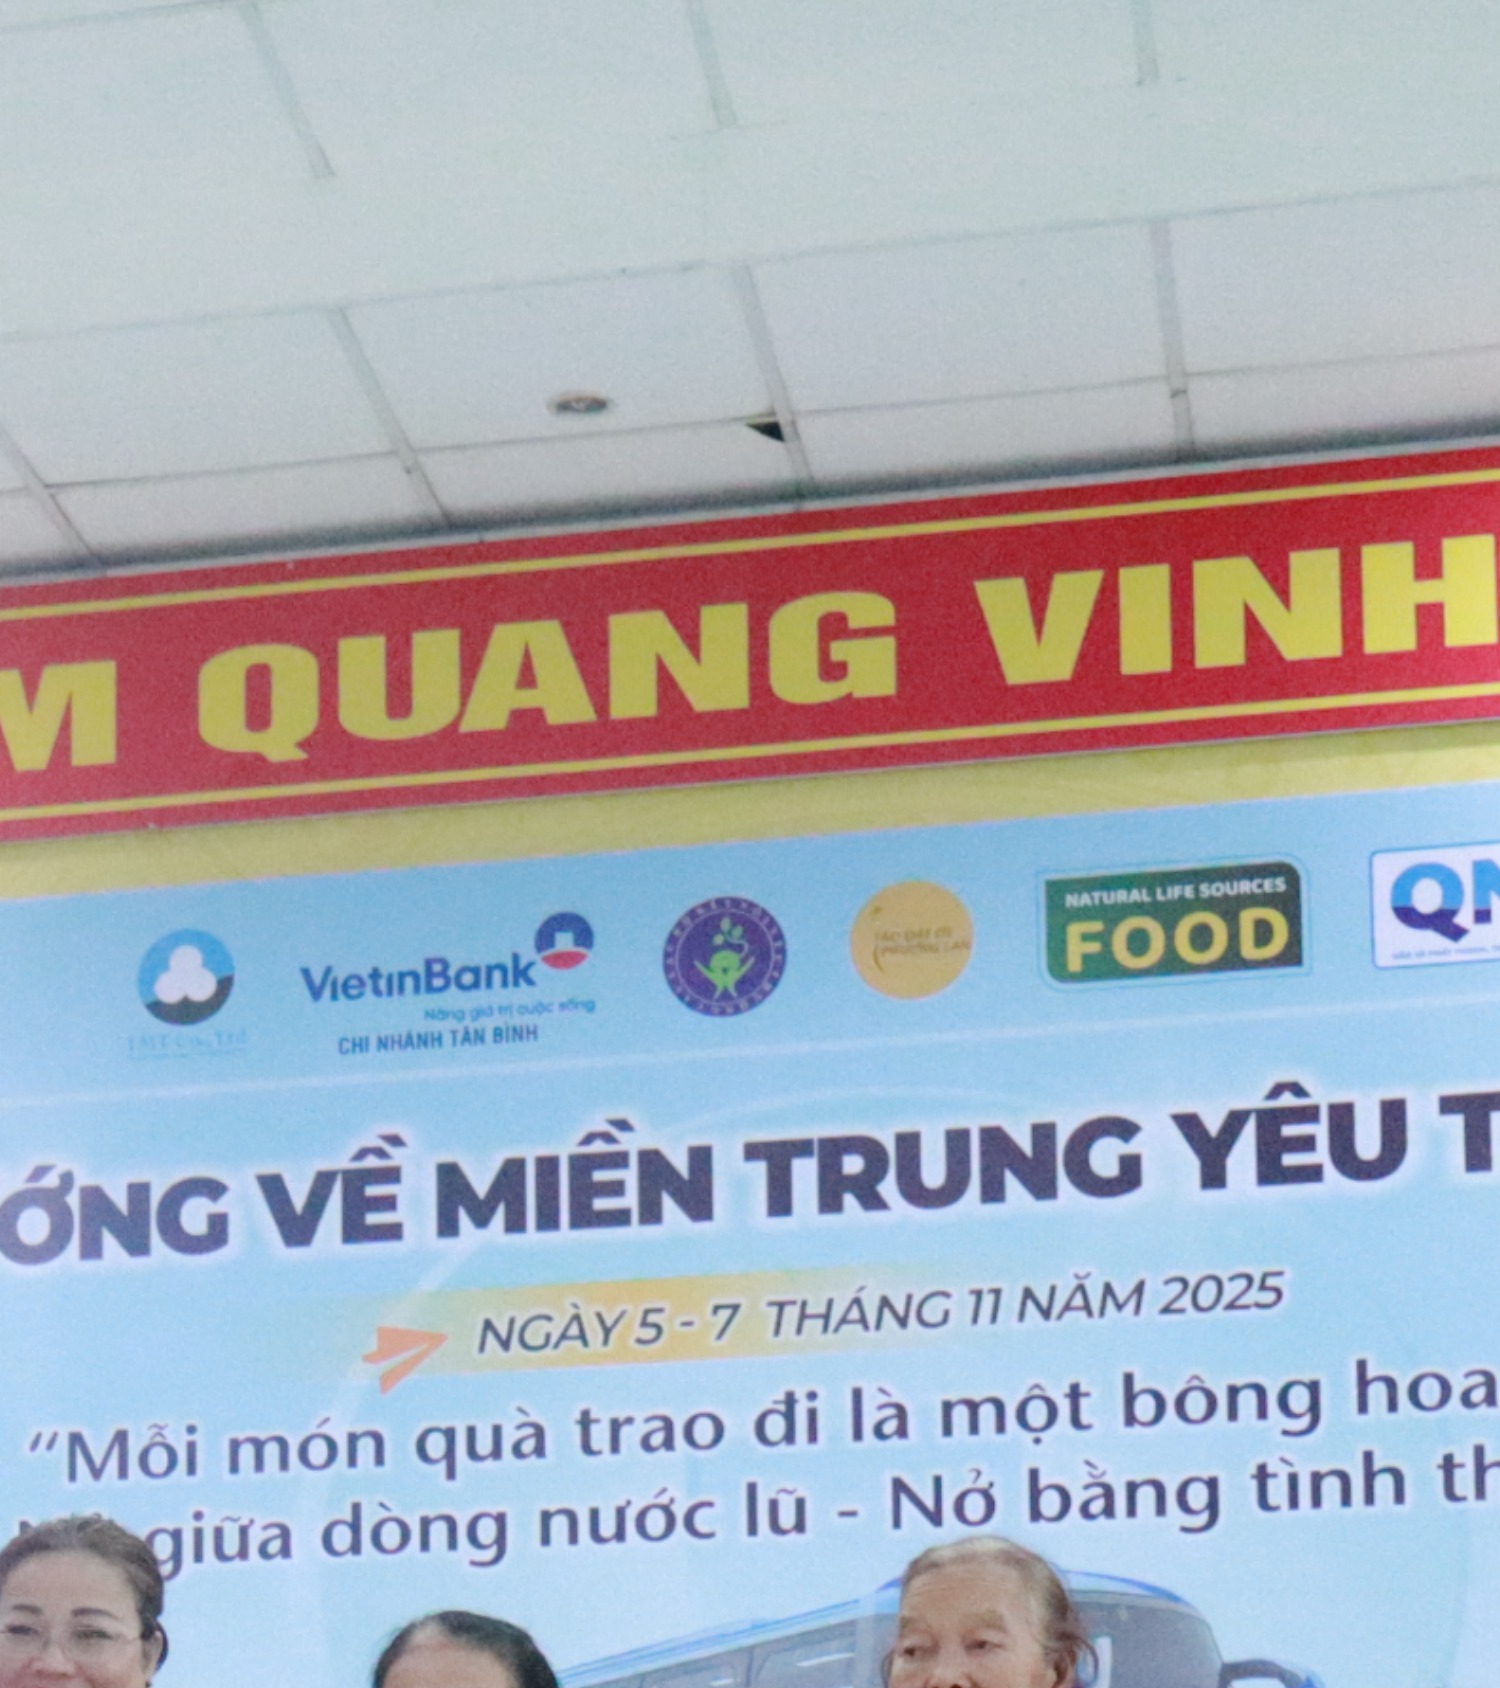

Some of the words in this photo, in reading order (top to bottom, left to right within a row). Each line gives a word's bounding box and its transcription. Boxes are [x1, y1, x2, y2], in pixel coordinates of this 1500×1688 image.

[197, 591, 899, 763] QUANG
[974, 532, 1499, 686] VINH
[1065, 888, 1152, 908] NATURAL
[1156, 883, 1194, 902] LIFE
[1200, 876, 1287, 899] SOURCES
[300, 952, 537, 1001] VietinBank
[1066, 906, 1289, 973] FOOD
[338, 1036, 370, 1056] CHI
[376, 1028, 443, 1053] NHÁNH
[450, 1024, 486, 1047] TÂN
[492, 1022, 539, 1044] BÌNH
[255, 1133, 408, 1249] VỀ
[436, 1119, 713, 1240] MIỀN
[743, 1114, 1142, 1220] TRUNG
[1171, 1081, 1409, 1191] YÊU
[478, 1306, 634, 1355] NGÀY
[634, 1306, 667, 1346] 5
[713, 1302, 741, 1342] 7
[766, 1286, 953, 1340] THÁNG
[966, 1286, 1003, 1328] 11
[1016, 1272, 1147, 1324] NĂM
[1158, 1269, 1286, 1315] 2025
[227, 1416, 388, 1475] món
[413, 1407, 548, 1482] quà
[575, 1406, 725, 1459] trao
[752, 1389, 822, 1447] đi
[849, 1386, 909, 1443] là
[939, 1381, 1093, 1445] một
[1121, 1371, 1323, 1438] bông
[1354, 1358, 1500, 1416] hoa
[146, 1508, 293, 1581] giữa
[321, 1500, 508, 1568] dòng
[538, 1487, 718, 1549] nước
[745, 1480, 809, 1539] lũ
[890, 1468, 999, 1531] Nở
[1028, 1459, 1221, 1534] bằng
[1251, 1450, 1407, 1513] tình
